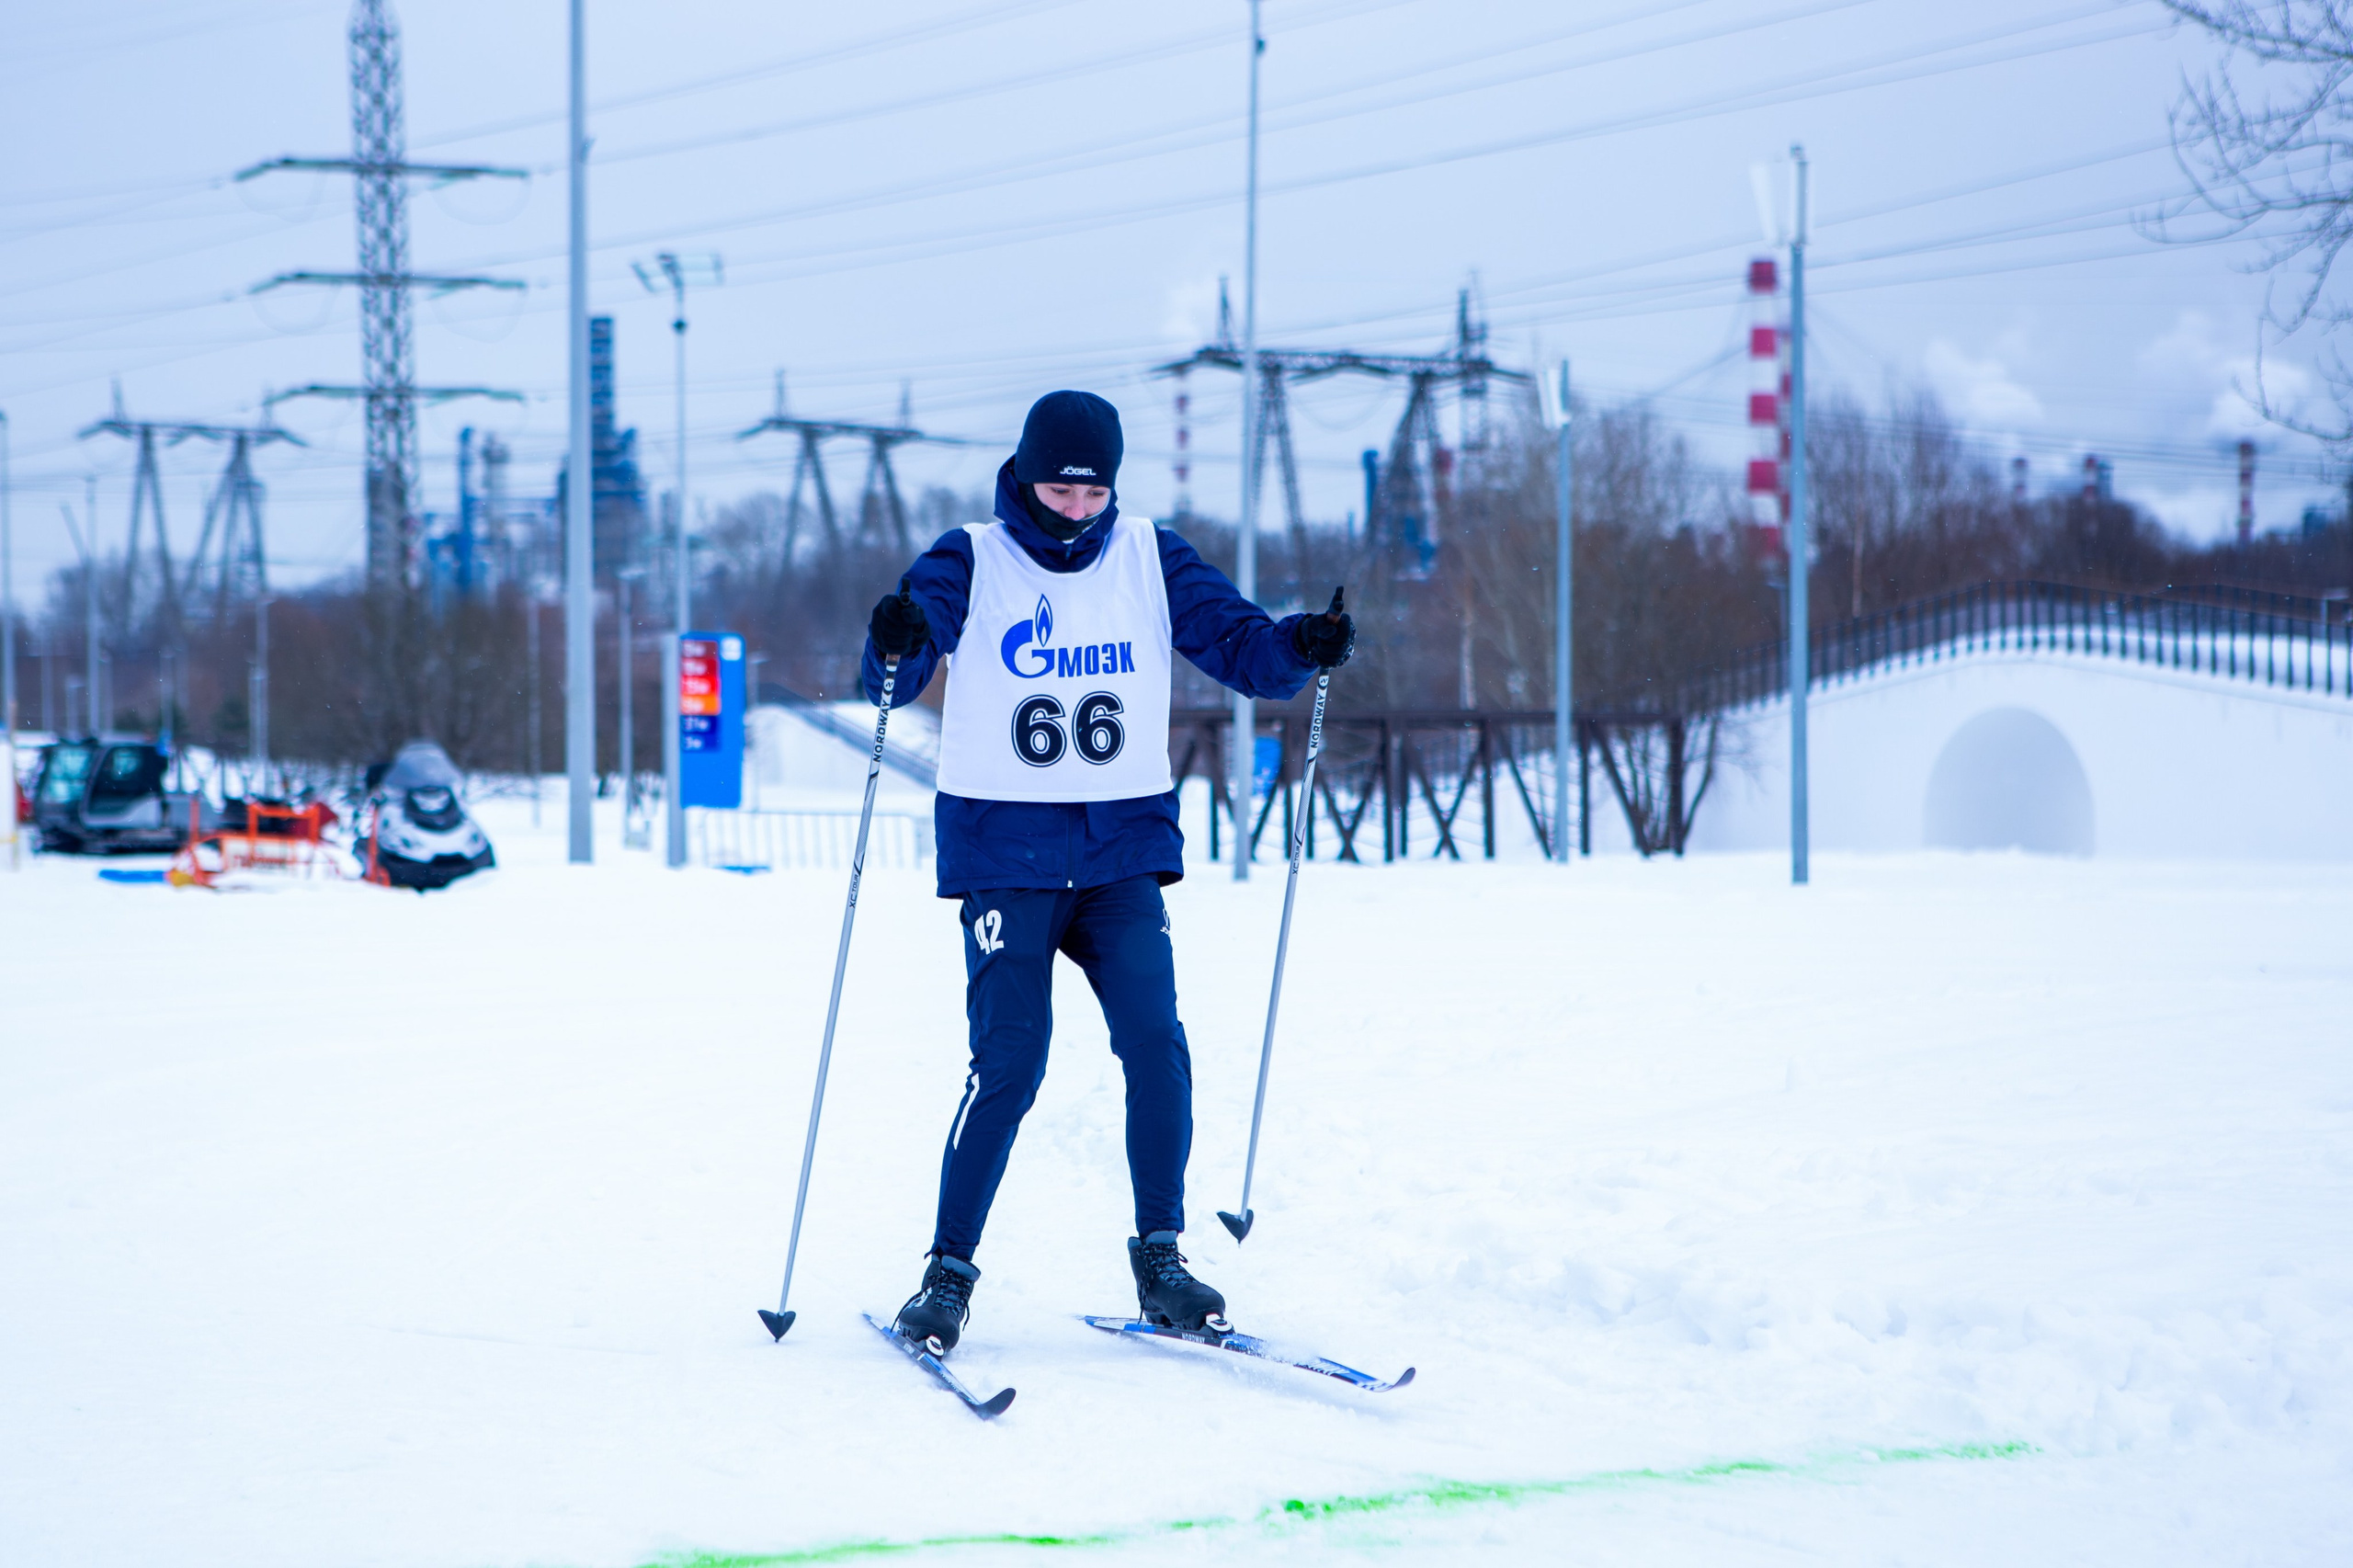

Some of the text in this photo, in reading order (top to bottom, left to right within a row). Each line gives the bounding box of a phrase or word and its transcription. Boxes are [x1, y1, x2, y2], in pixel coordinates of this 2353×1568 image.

[1060, 465, 1097, 476] JÖGEL
[872, 699, 891, 763] NORDWAY
[1011, 691, 1125, 767] 66
[1310, 694, 1325, 749] NORDWAY
[848, 873, 859, 909] XC TOUR
[1291, 861, 1300, 875] XC
[974, 909, 1005, 955] 42
